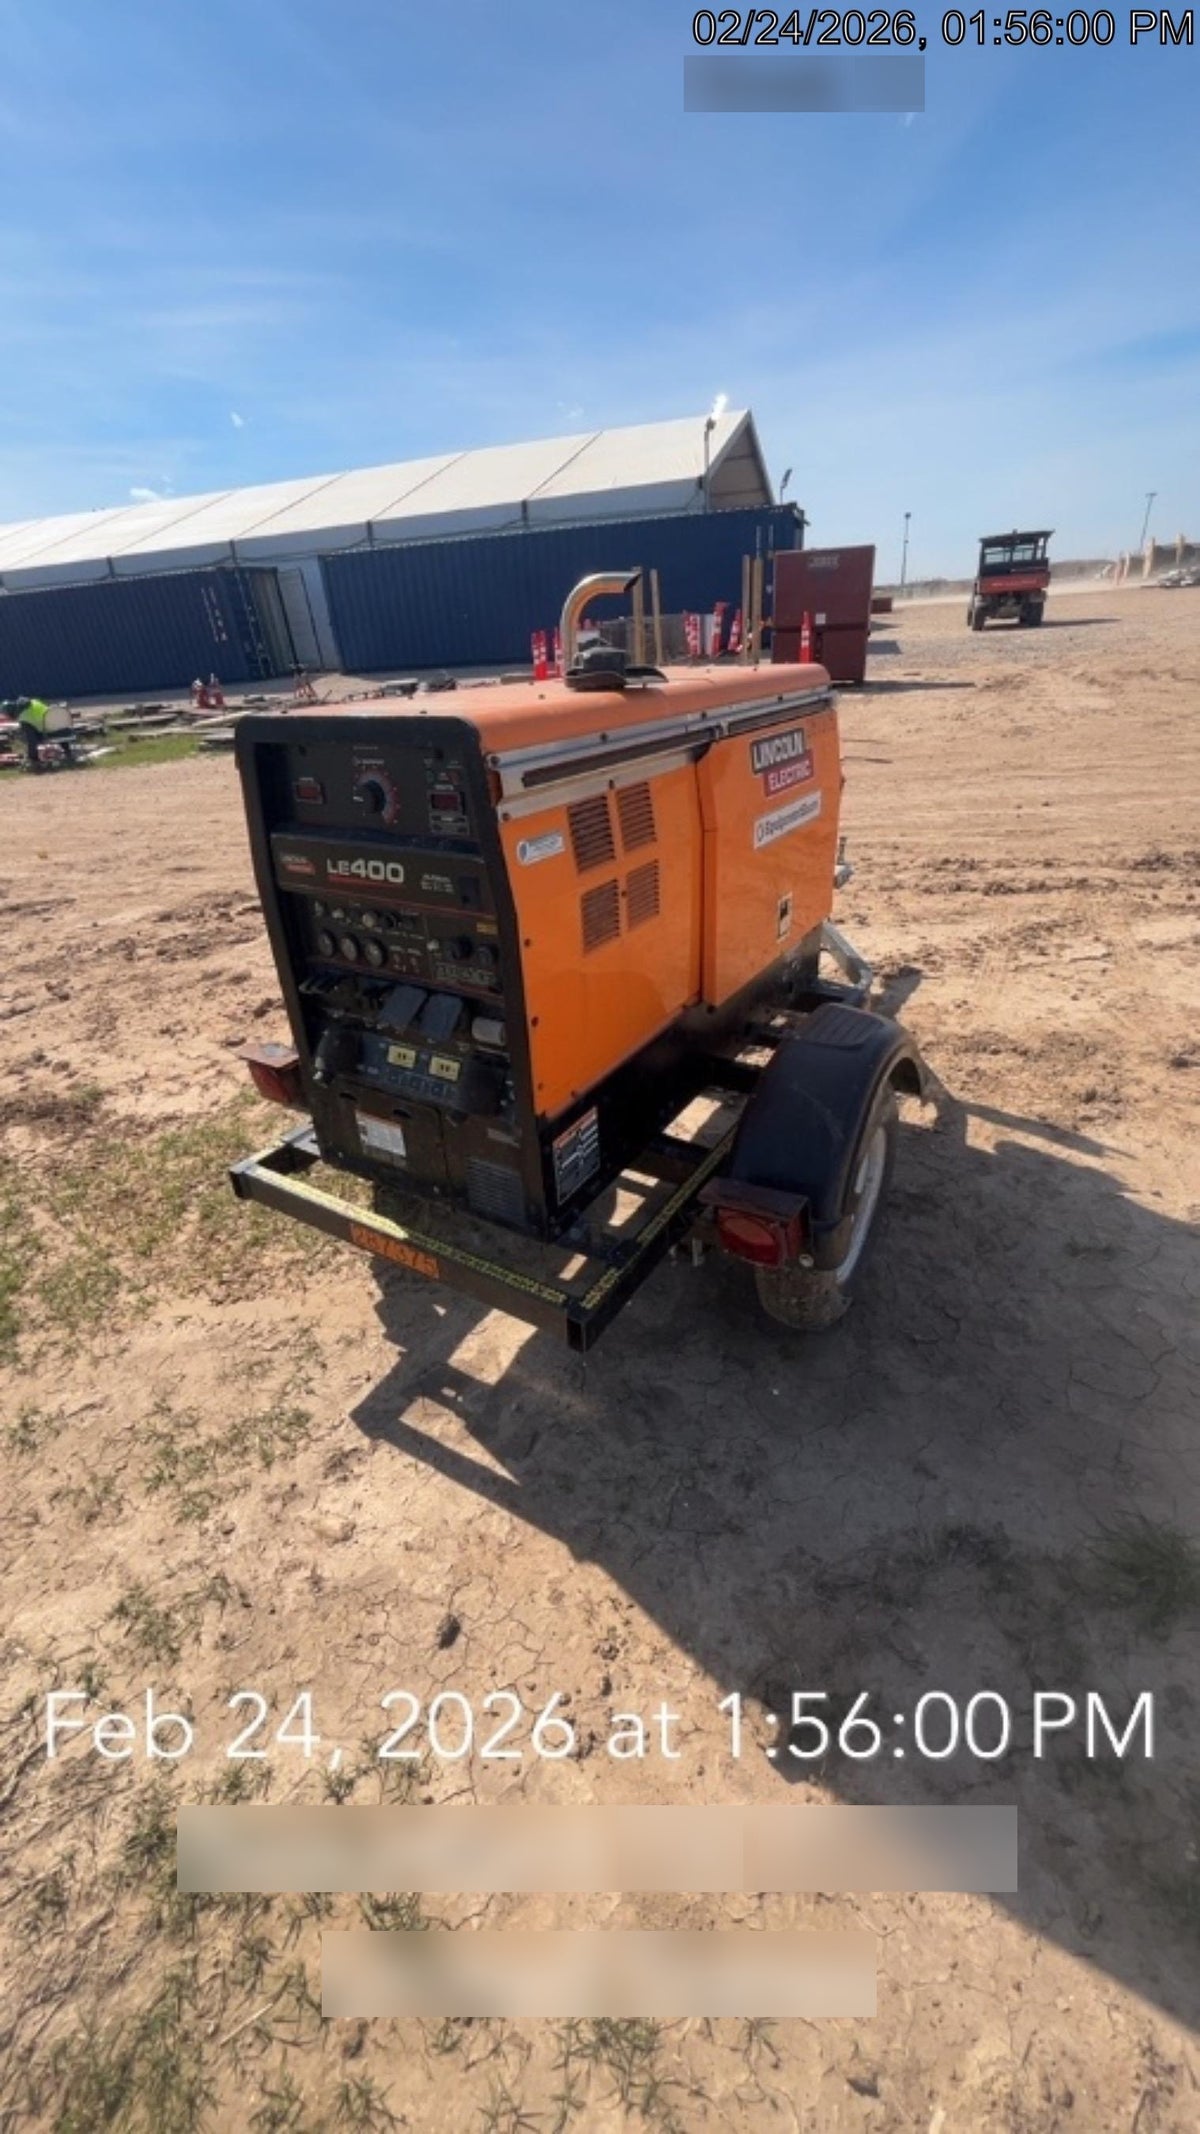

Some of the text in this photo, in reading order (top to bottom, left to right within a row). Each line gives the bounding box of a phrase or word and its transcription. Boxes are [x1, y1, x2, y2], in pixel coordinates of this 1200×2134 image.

[753, 730, 804, 771] LINCOLN
[767, 758, 811, 792] ELECTRIC
[326, 857, 405, 884] LE400
